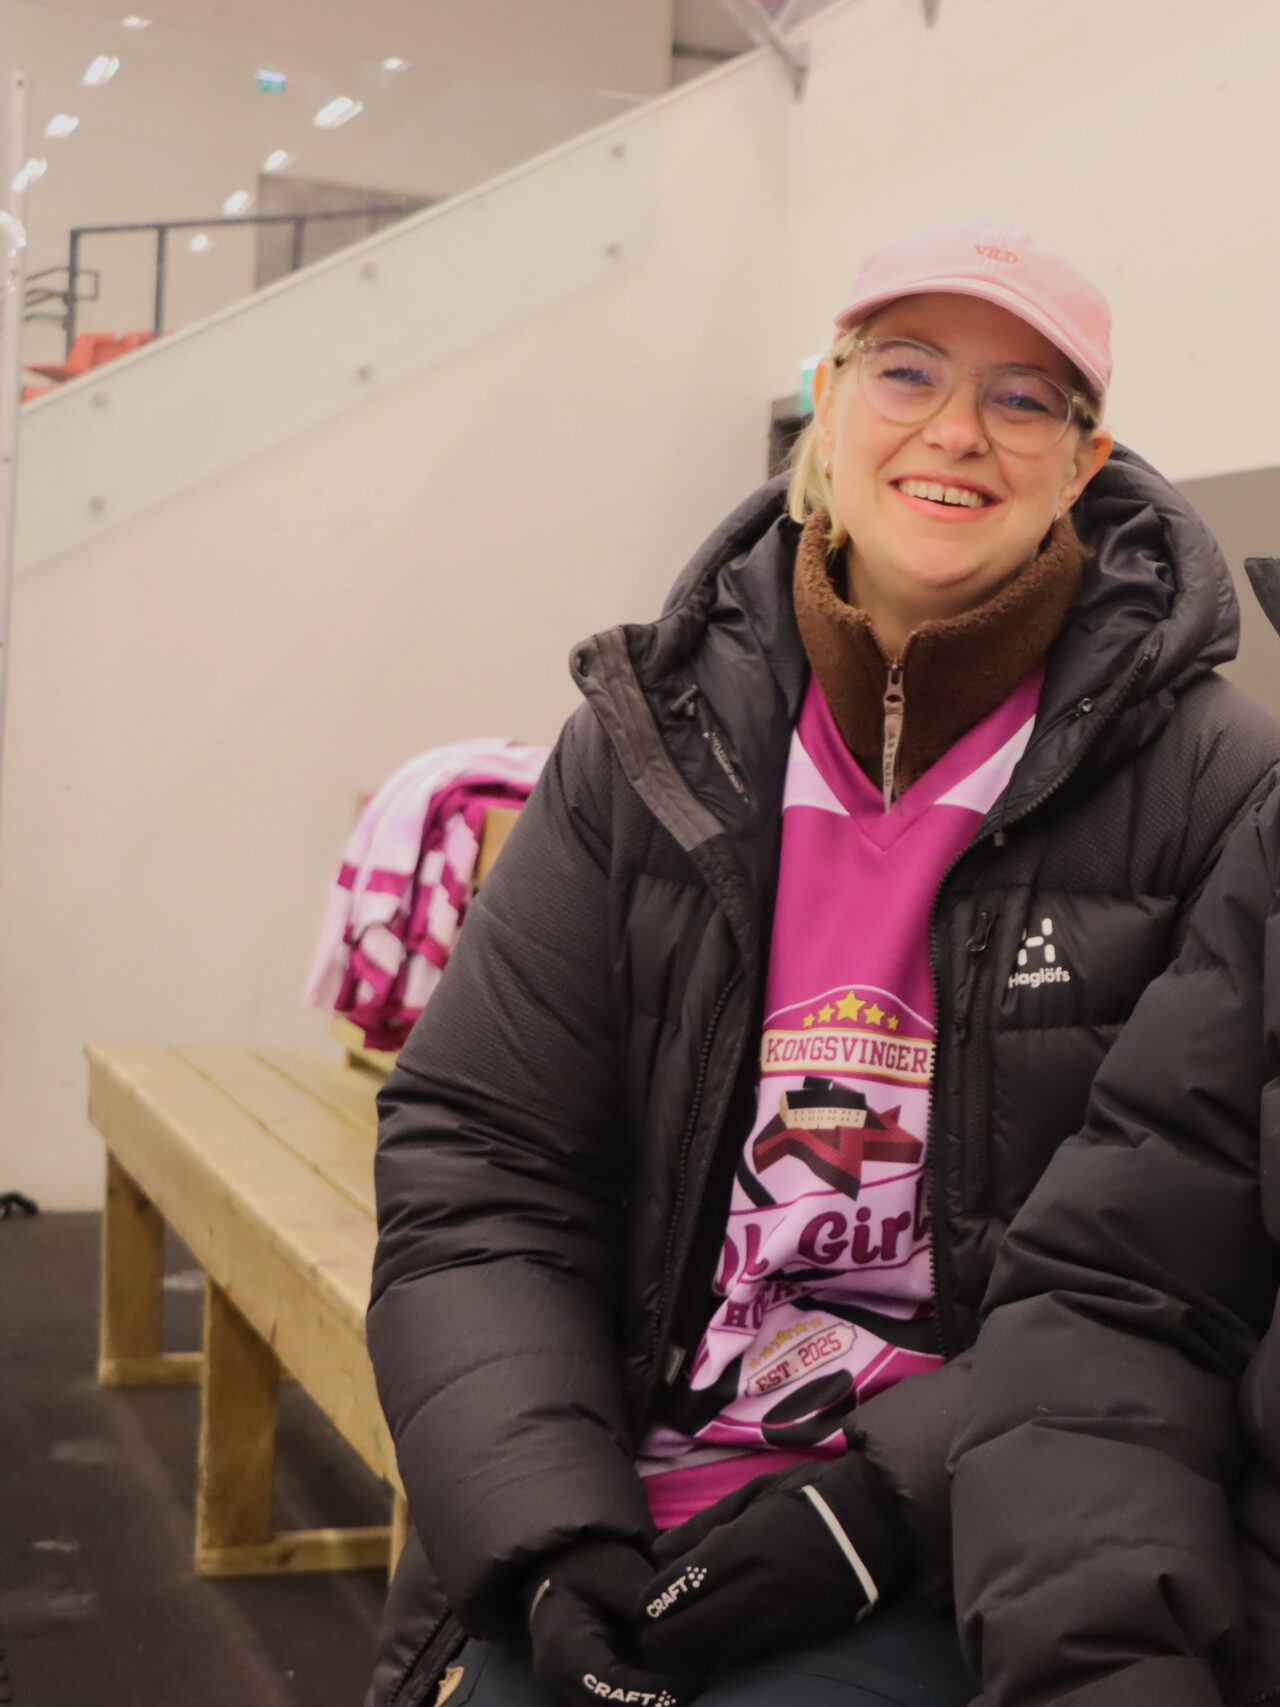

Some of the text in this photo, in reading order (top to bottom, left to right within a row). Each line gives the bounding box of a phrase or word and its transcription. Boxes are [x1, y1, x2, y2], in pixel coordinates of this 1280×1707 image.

[1008, 966, 1071, 989] Haglöfs
[766, 1036, 928, 1074] KONGSVINGER
[798, 1331, 842, 1367] 2025
[646, 1575, 688, 1618] CRAFT
[583, 1673, 657, 1706] CRAFT
